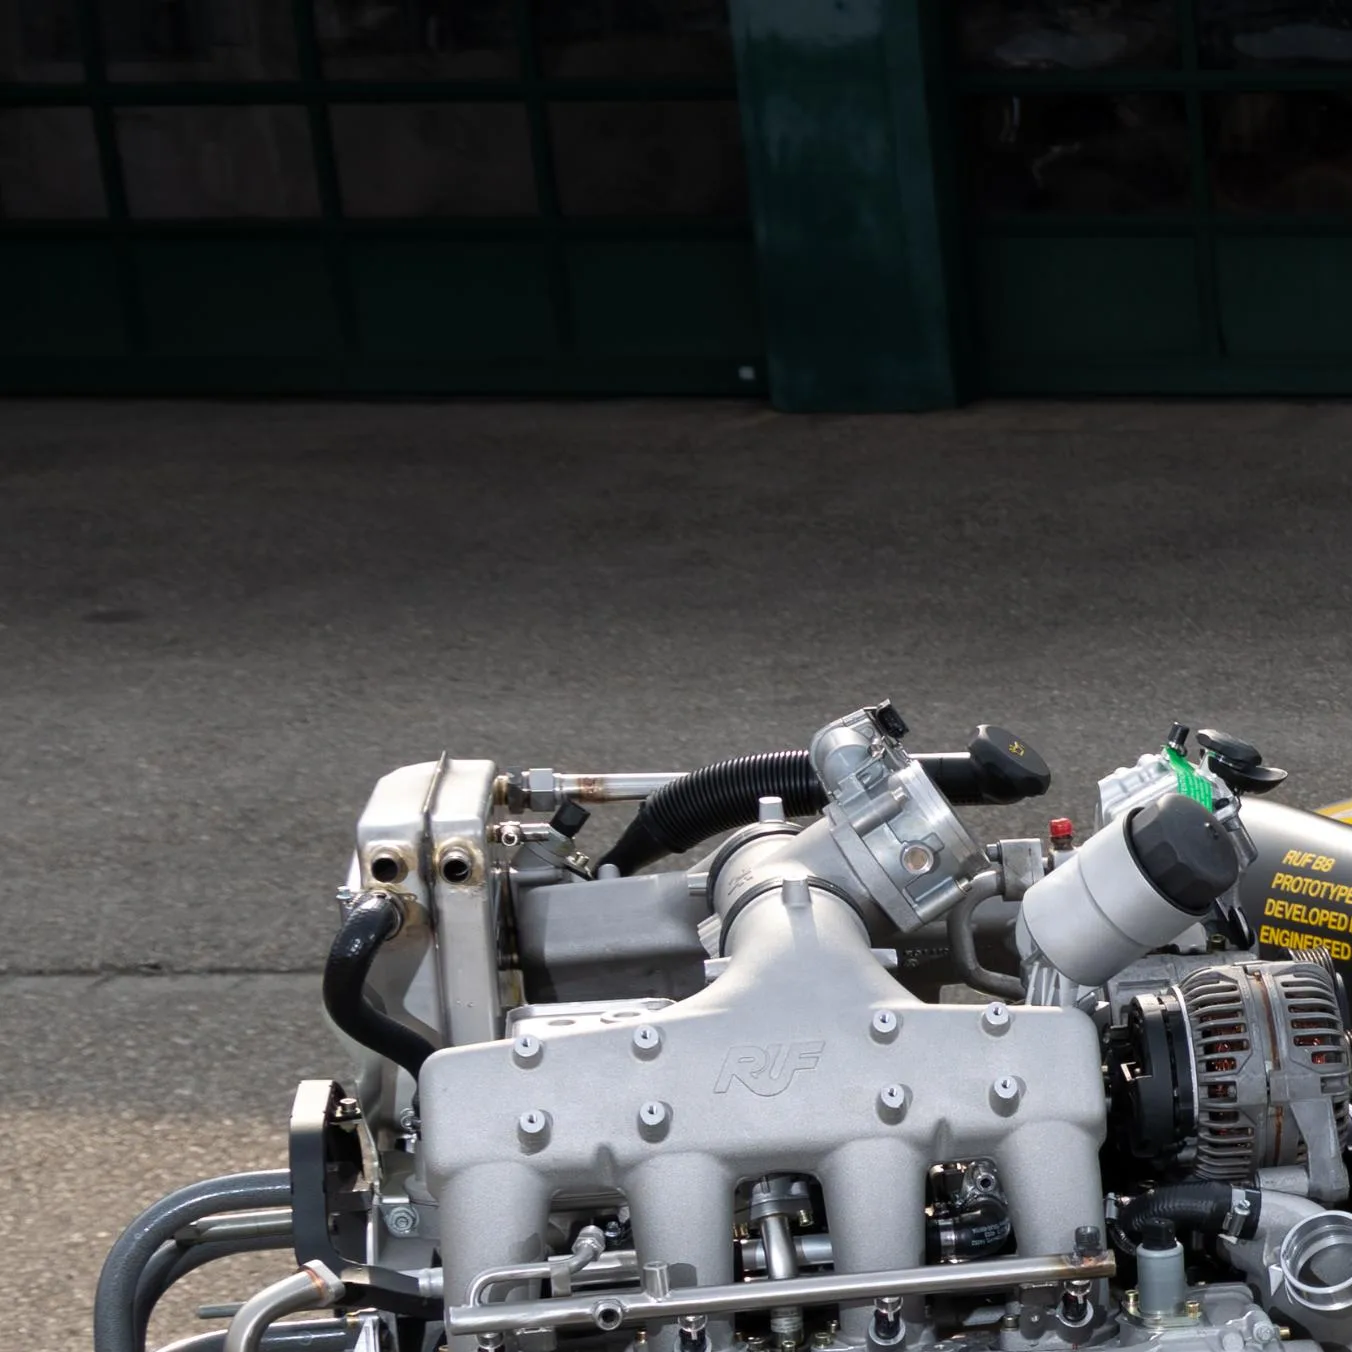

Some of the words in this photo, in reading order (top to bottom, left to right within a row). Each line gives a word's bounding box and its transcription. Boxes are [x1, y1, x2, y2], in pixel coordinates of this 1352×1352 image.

[1282, 849, 1314, 868] RUF
[1312, 855, 1336, 873] B8
[1264, 897, 1349, 932] DEVELOPED
